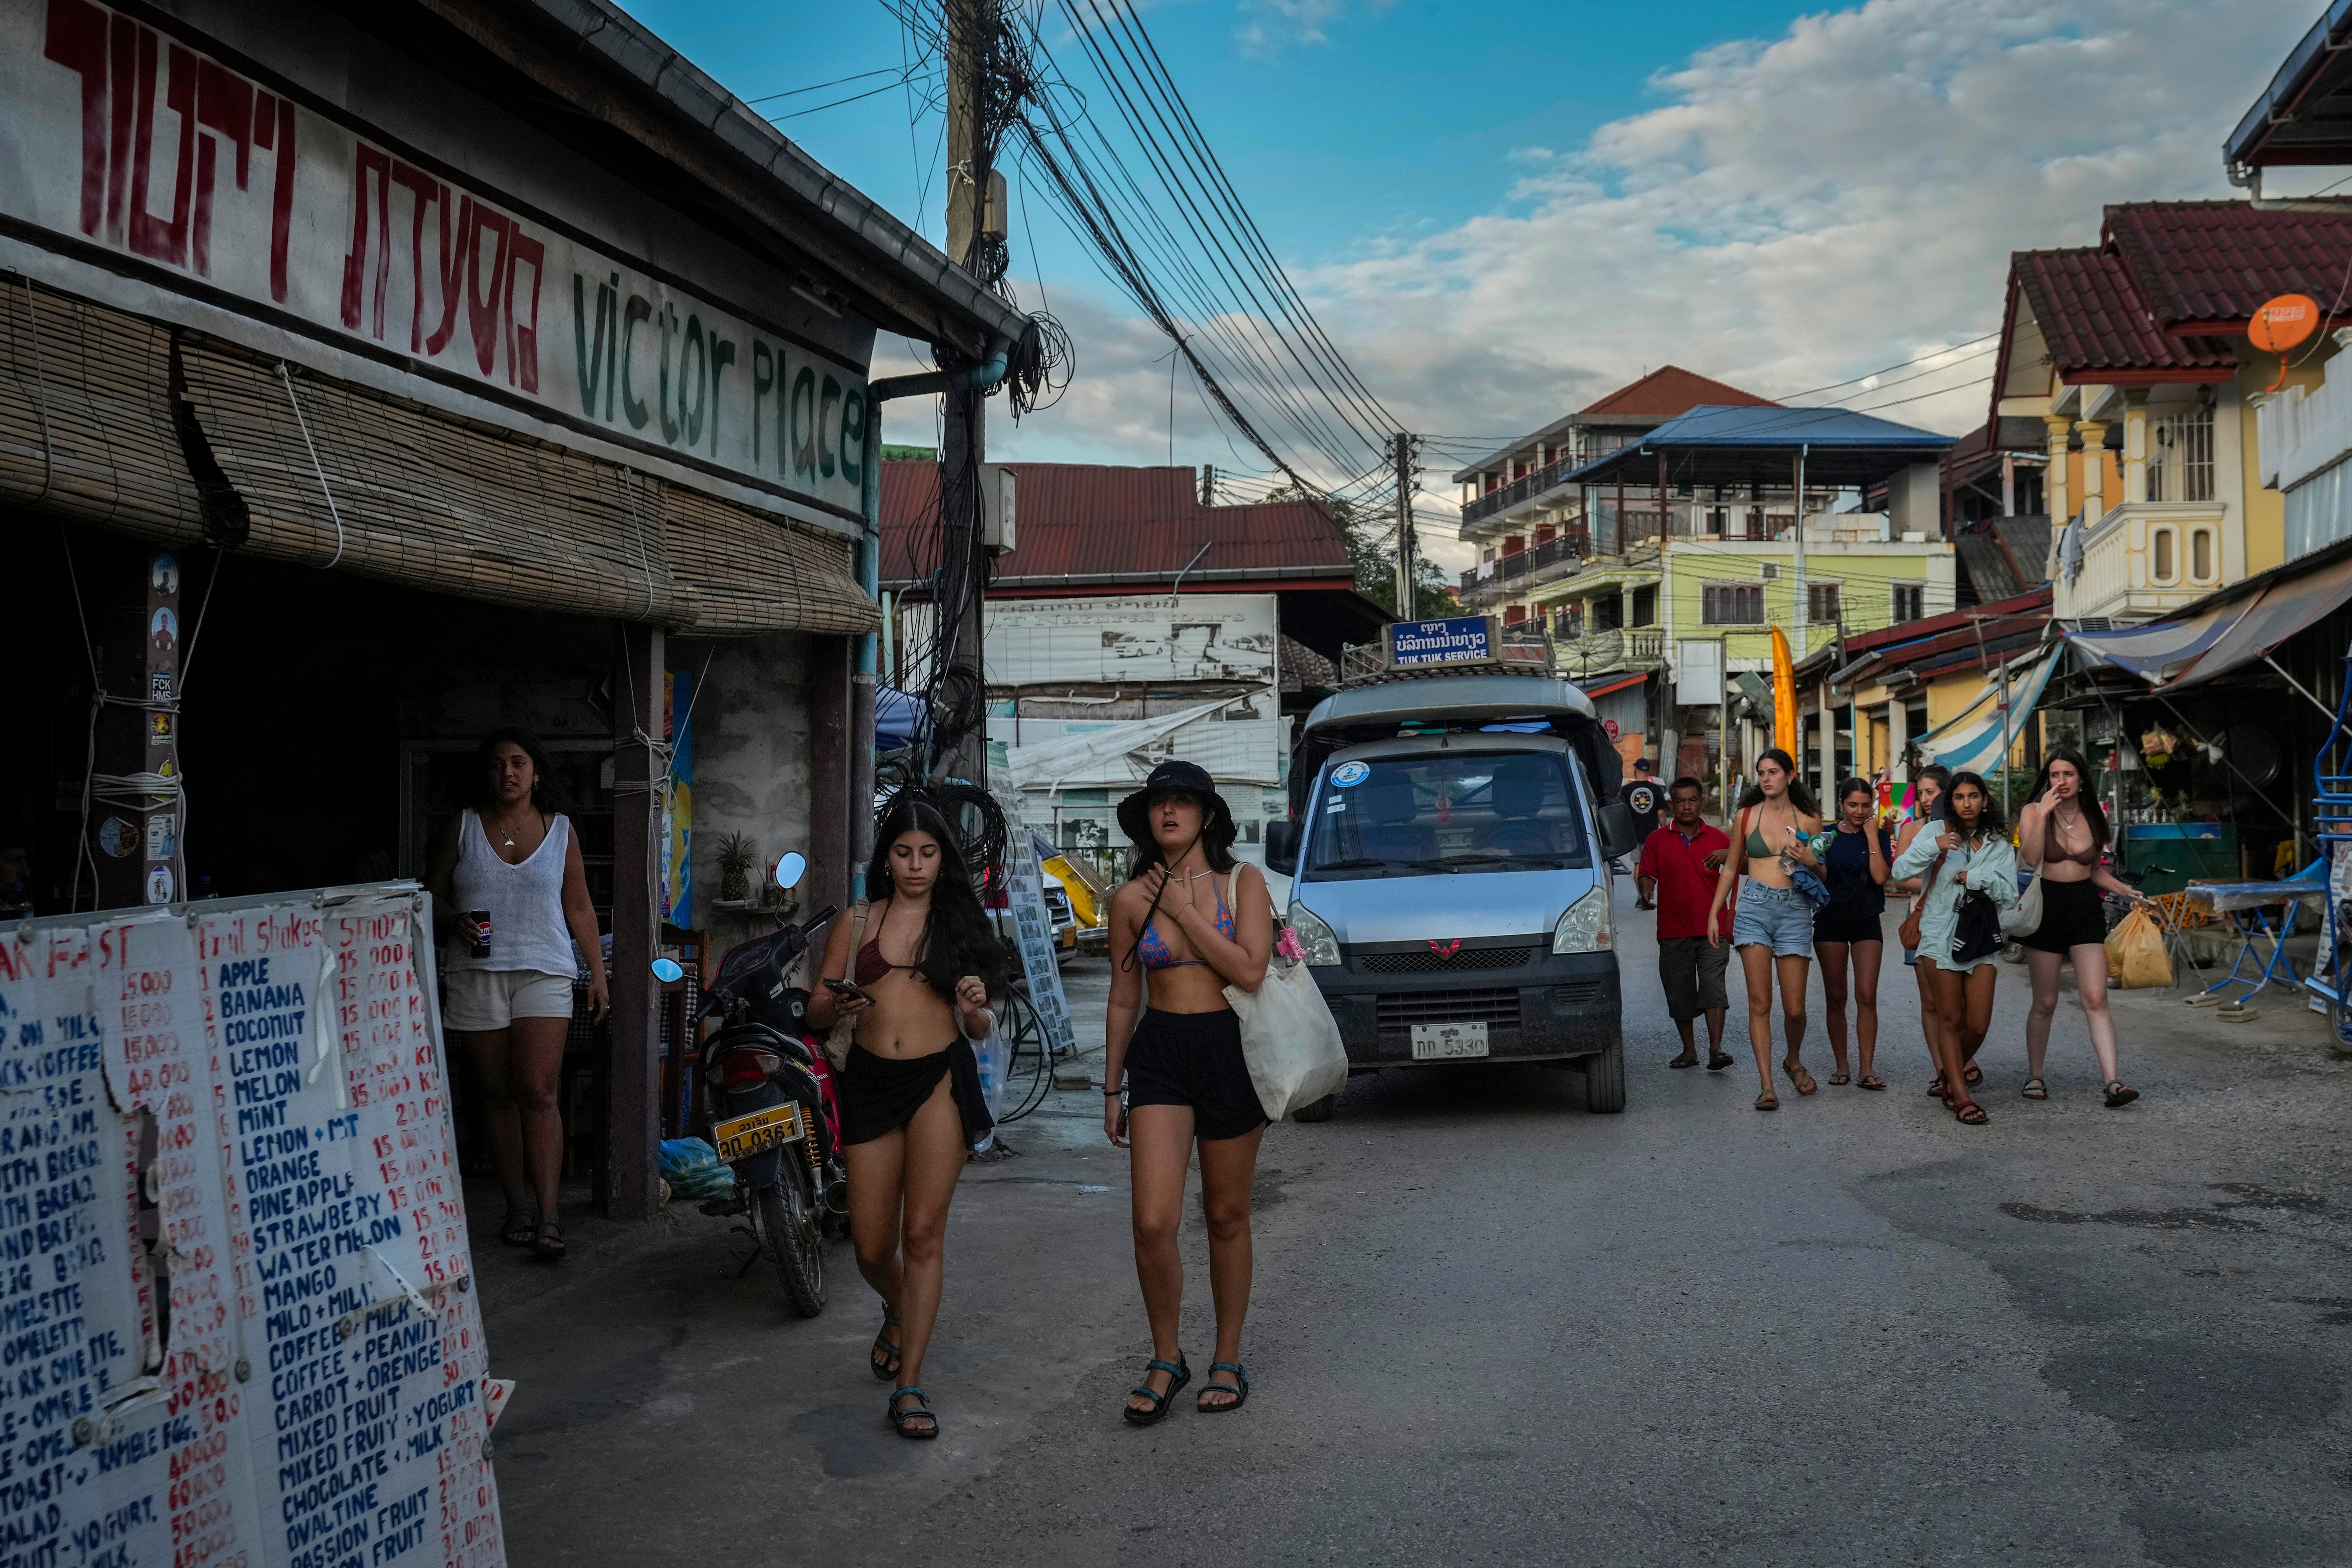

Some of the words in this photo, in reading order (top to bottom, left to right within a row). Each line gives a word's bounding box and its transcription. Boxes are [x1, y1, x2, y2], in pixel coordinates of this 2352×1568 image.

[45, 0, 294, 304] ויקטור
[341, 142, 544, 394] מסעדת
[573, 271, 735, 457] Victor
[754, 340, 863, 486] Place
[1035, 612, 1155, 626] Natural
[1398, 655, 1419, 665] TUK
[1421, 652, 1443, 662] TUK
[1445, 649, 1487, 661] SERVICE
[152, 679, 171, 690] FCK
[219, 957, 269, 988] APPLE
[221, 983, 305, 1018] BANANA
[225, 1010, 305, 1047] COCONUT
[1444, 1038, 1485, 1055] 5330
[231, 1041, 298, 1077] LEMON
[214, 1085, 225, 1108] 5
[234, 1069, 301, 1106] MELON
[241, 1125, 308, 1167] LEMON
[751, 1121, 796, 1146] 0361
[246, 1151, 321, 1194] ORANGE
[254, 1193, 380, 1255] STRAWBERY
[263, 1264, 337, 1312] MANGO
[266, 1304, 311, 1342] MILO
[269, 1322, 343, 1372] COFFEE
[365, 1298, 410, 1333] MILK
[274, 1350, 345, 1401] COFFEE
[365, 1314, 441, 1363] PEANUT
[276, 1376, 350, 1431] CARROT
[367, 1341, 441, 1392] ORENGE
[278, 1412, 337, 1461] MIXED
[344, 1385, 400, 1431] FRUIT
[279, 1444, 337, 1493] MIXED
[282, 1448, 388, 1523] CHOCOLATE
[287, 1483, 378, 1552] OVALTINE
[291, 1515, 369, 1568] PASSION
[377, 1486, 429, 1535] FRUIT
[372, 1517, 426, 1568] FRUIT
